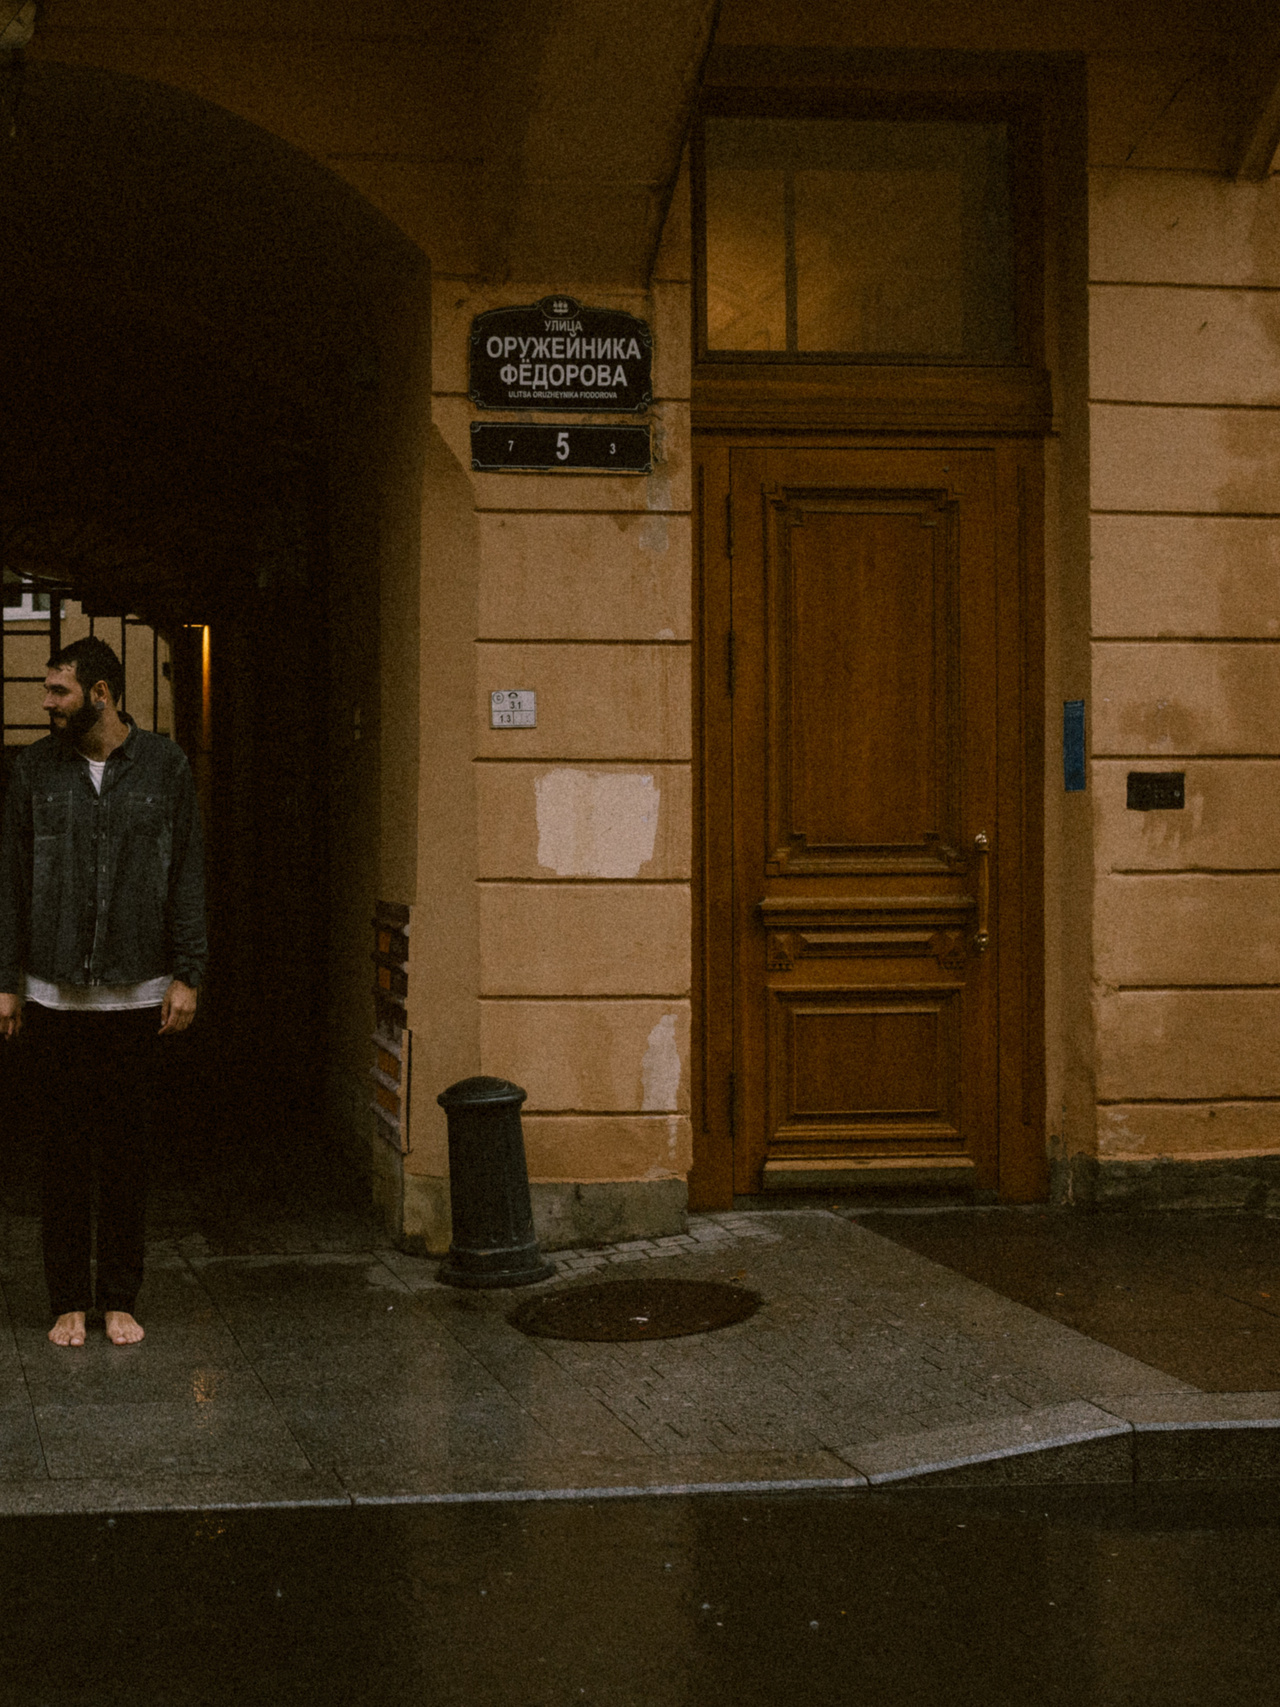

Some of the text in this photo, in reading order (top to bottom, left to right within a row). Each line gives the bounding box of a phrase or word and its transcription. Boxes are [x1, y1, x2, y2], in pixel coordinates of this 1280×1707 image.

[544, 320, 583, 332] УЛИЦА
[486, 332, 642, 360] ОРУЖЕЙНИКА
[499, 359, 629, 390] ФЁДОРОВА
[508, 390, 532, 398] ULITSA
[508, 432, 616, 460] 7 5 3
